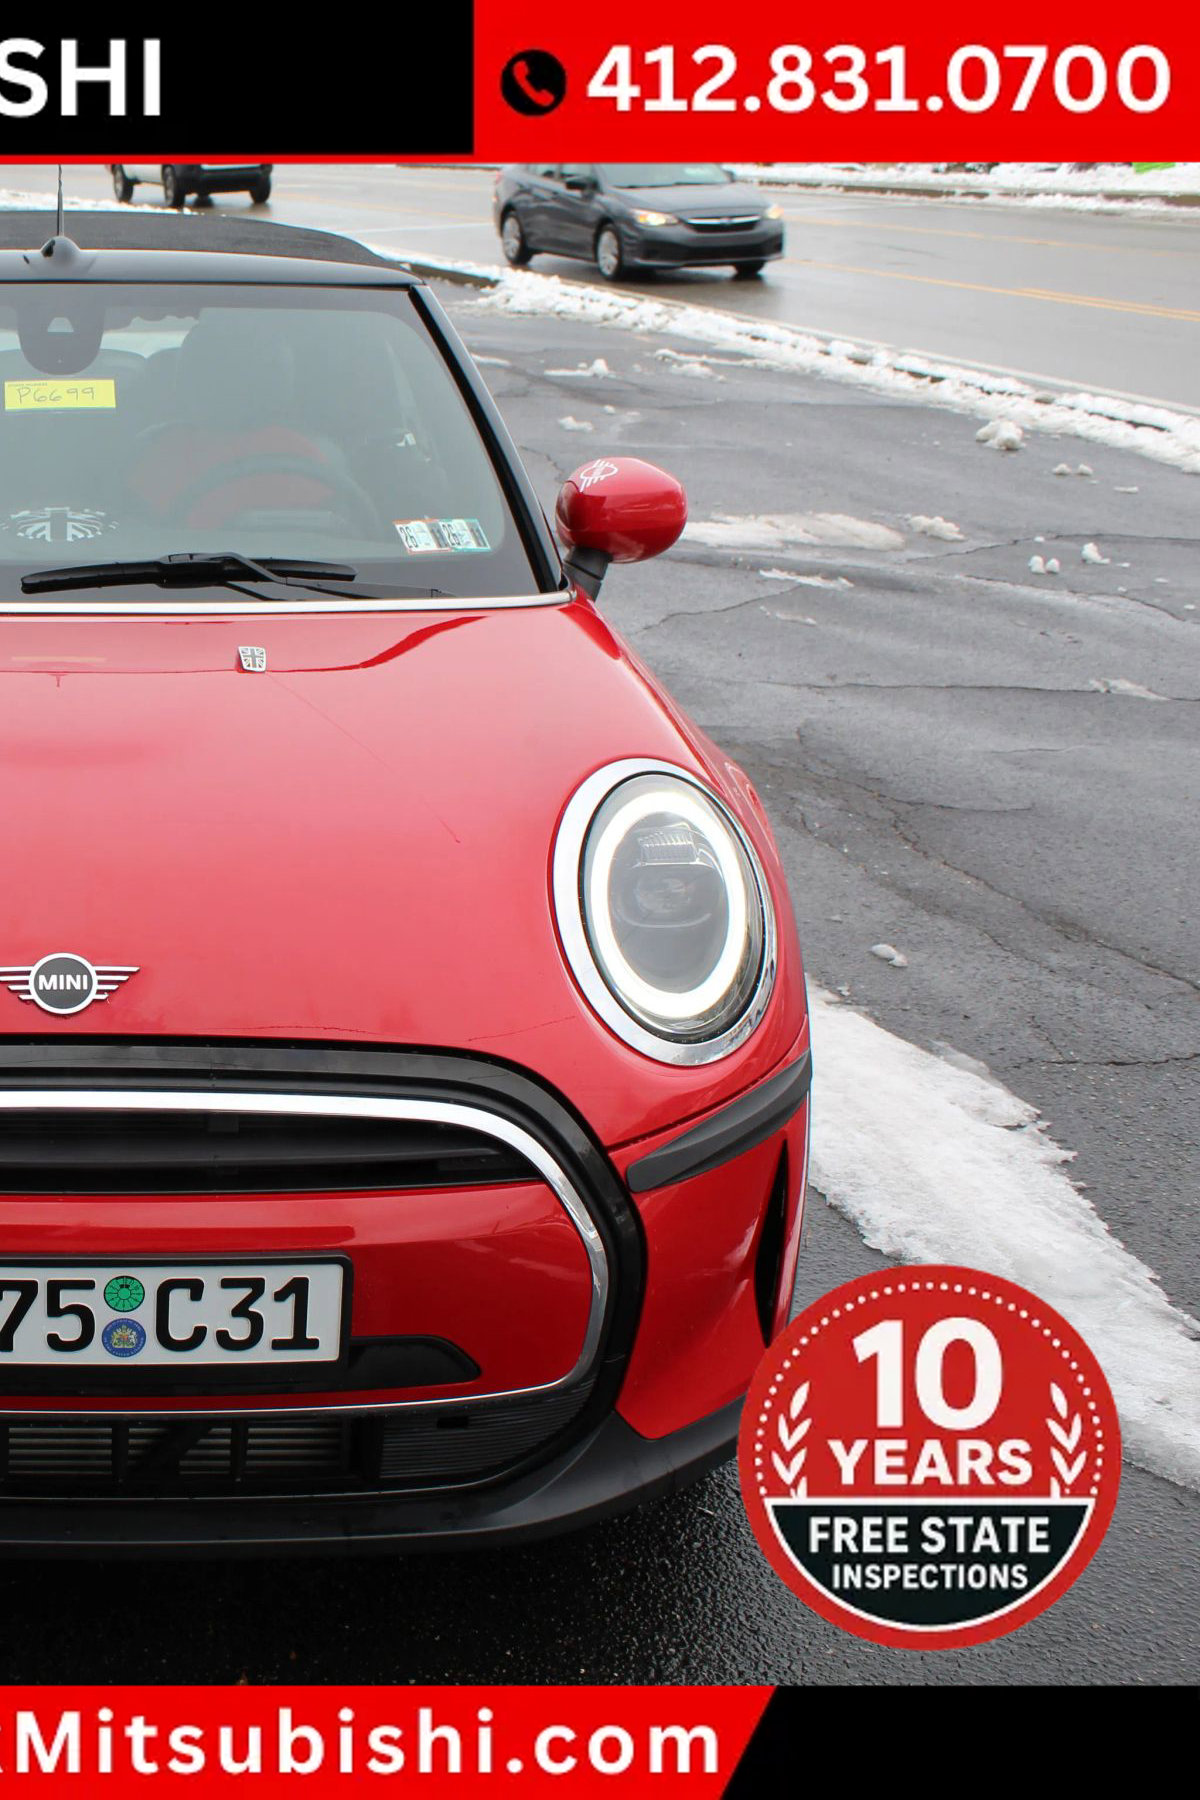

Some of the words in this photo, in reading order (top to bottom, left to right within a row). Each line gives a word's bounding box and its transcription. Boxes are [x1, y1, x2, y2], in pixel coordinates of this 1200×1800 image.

[17, 386, 95, 404] P6699
[38, 974, 88, 991] MINI
[155, 1276, 320, 1352] C31
